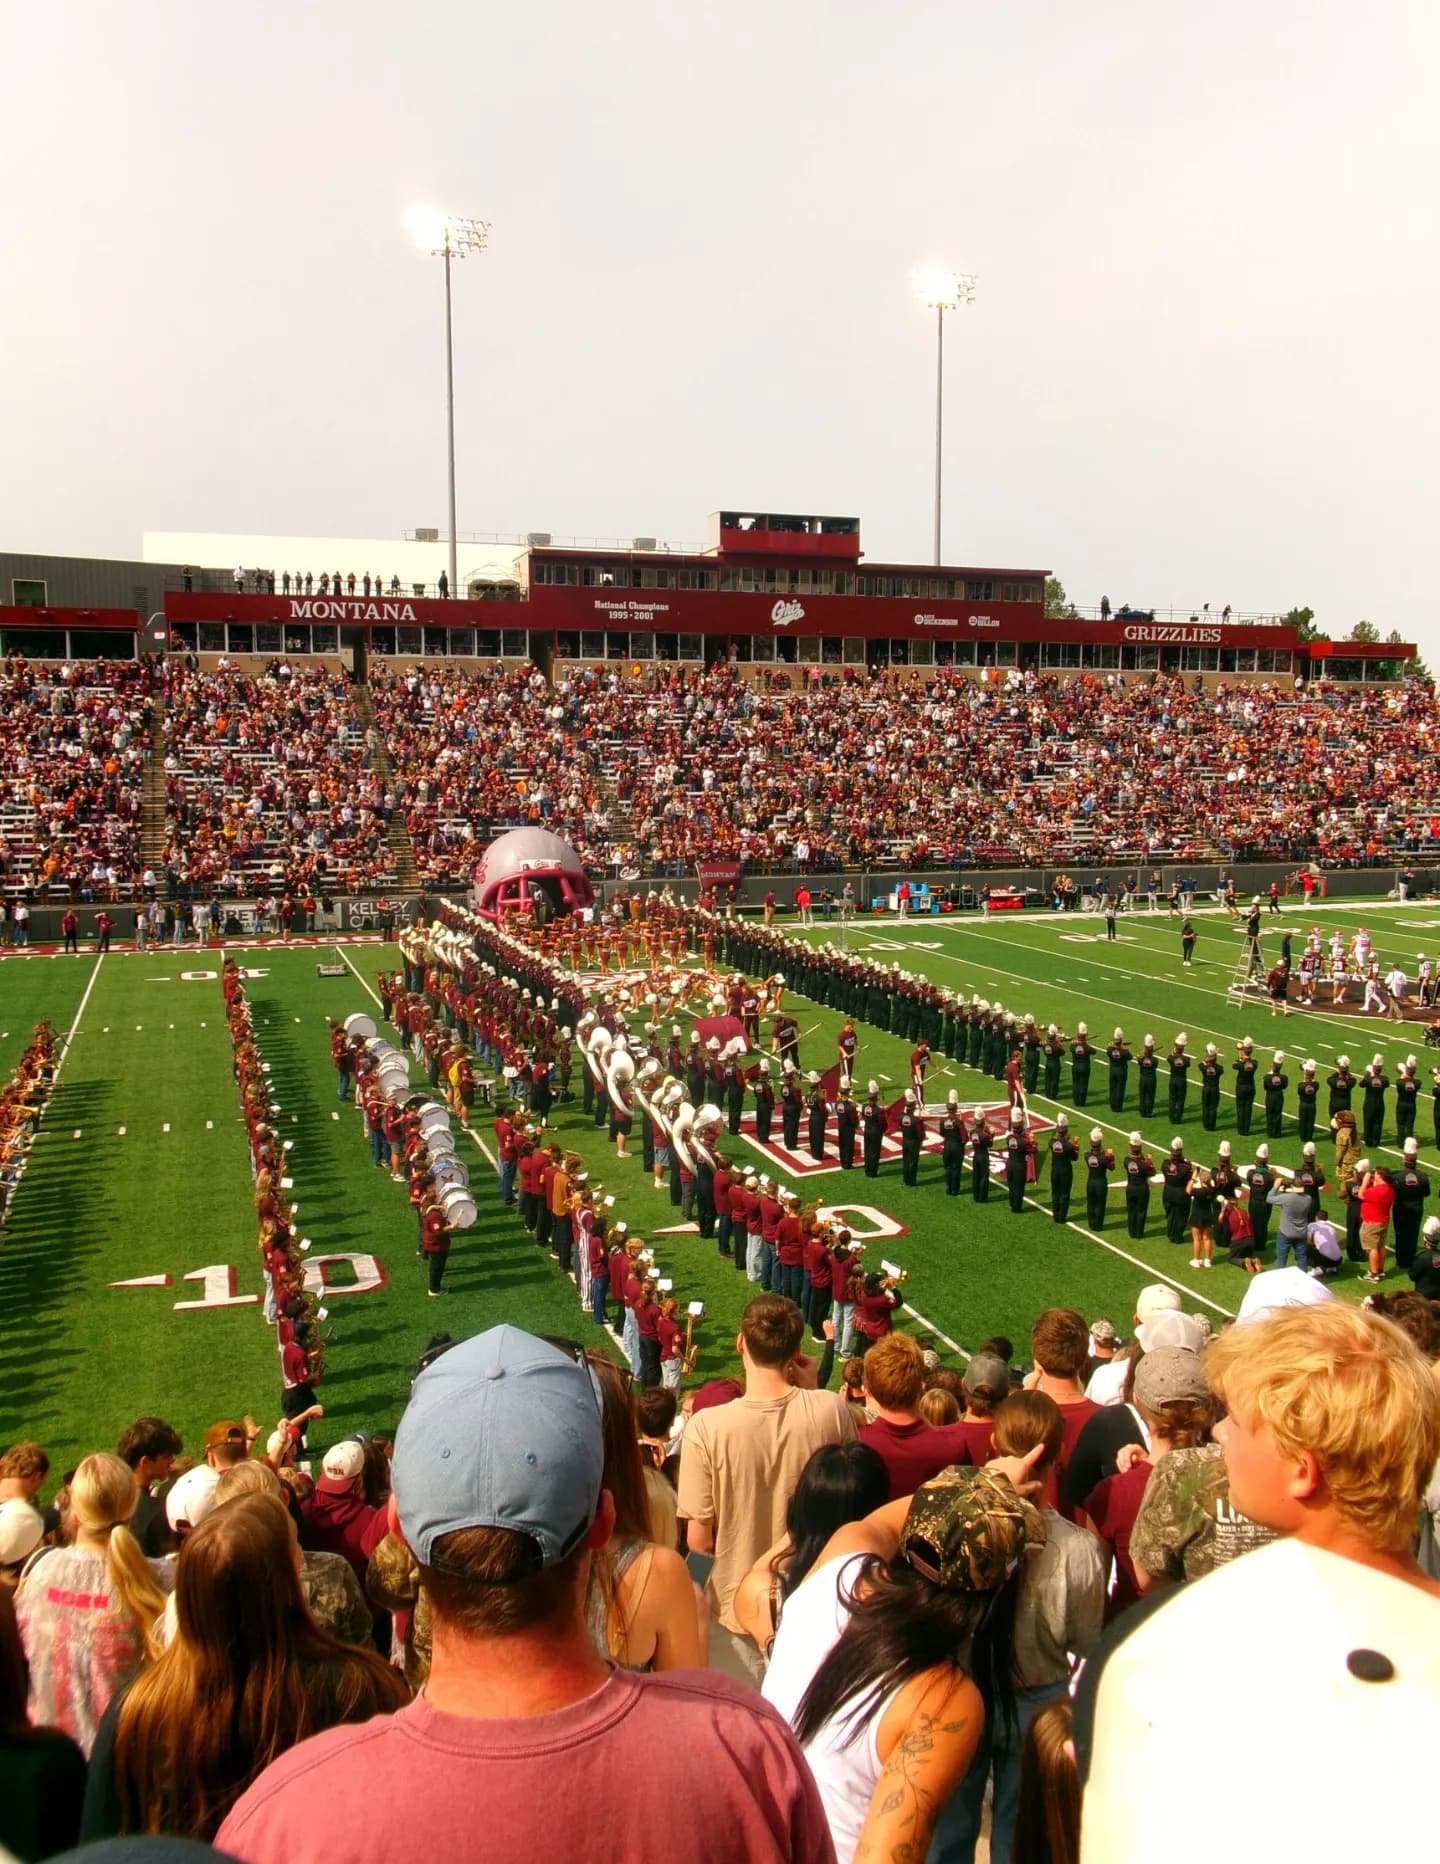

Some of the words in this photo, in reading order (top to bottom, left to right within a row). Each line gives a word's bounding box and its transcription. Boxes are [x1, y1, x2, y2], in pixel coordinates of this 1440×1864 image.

[290, 600, 417, 620] MONTANA
[594, 600, 627, 609] National
[628, 601, 669, 611] Champions
[609, 611, 628, 619] 1995
[634, 612, 653, 620] 2001
[1124, 625, 1222, 642] GRIZZLIES
[172, 1252, 389, 1312] 10
